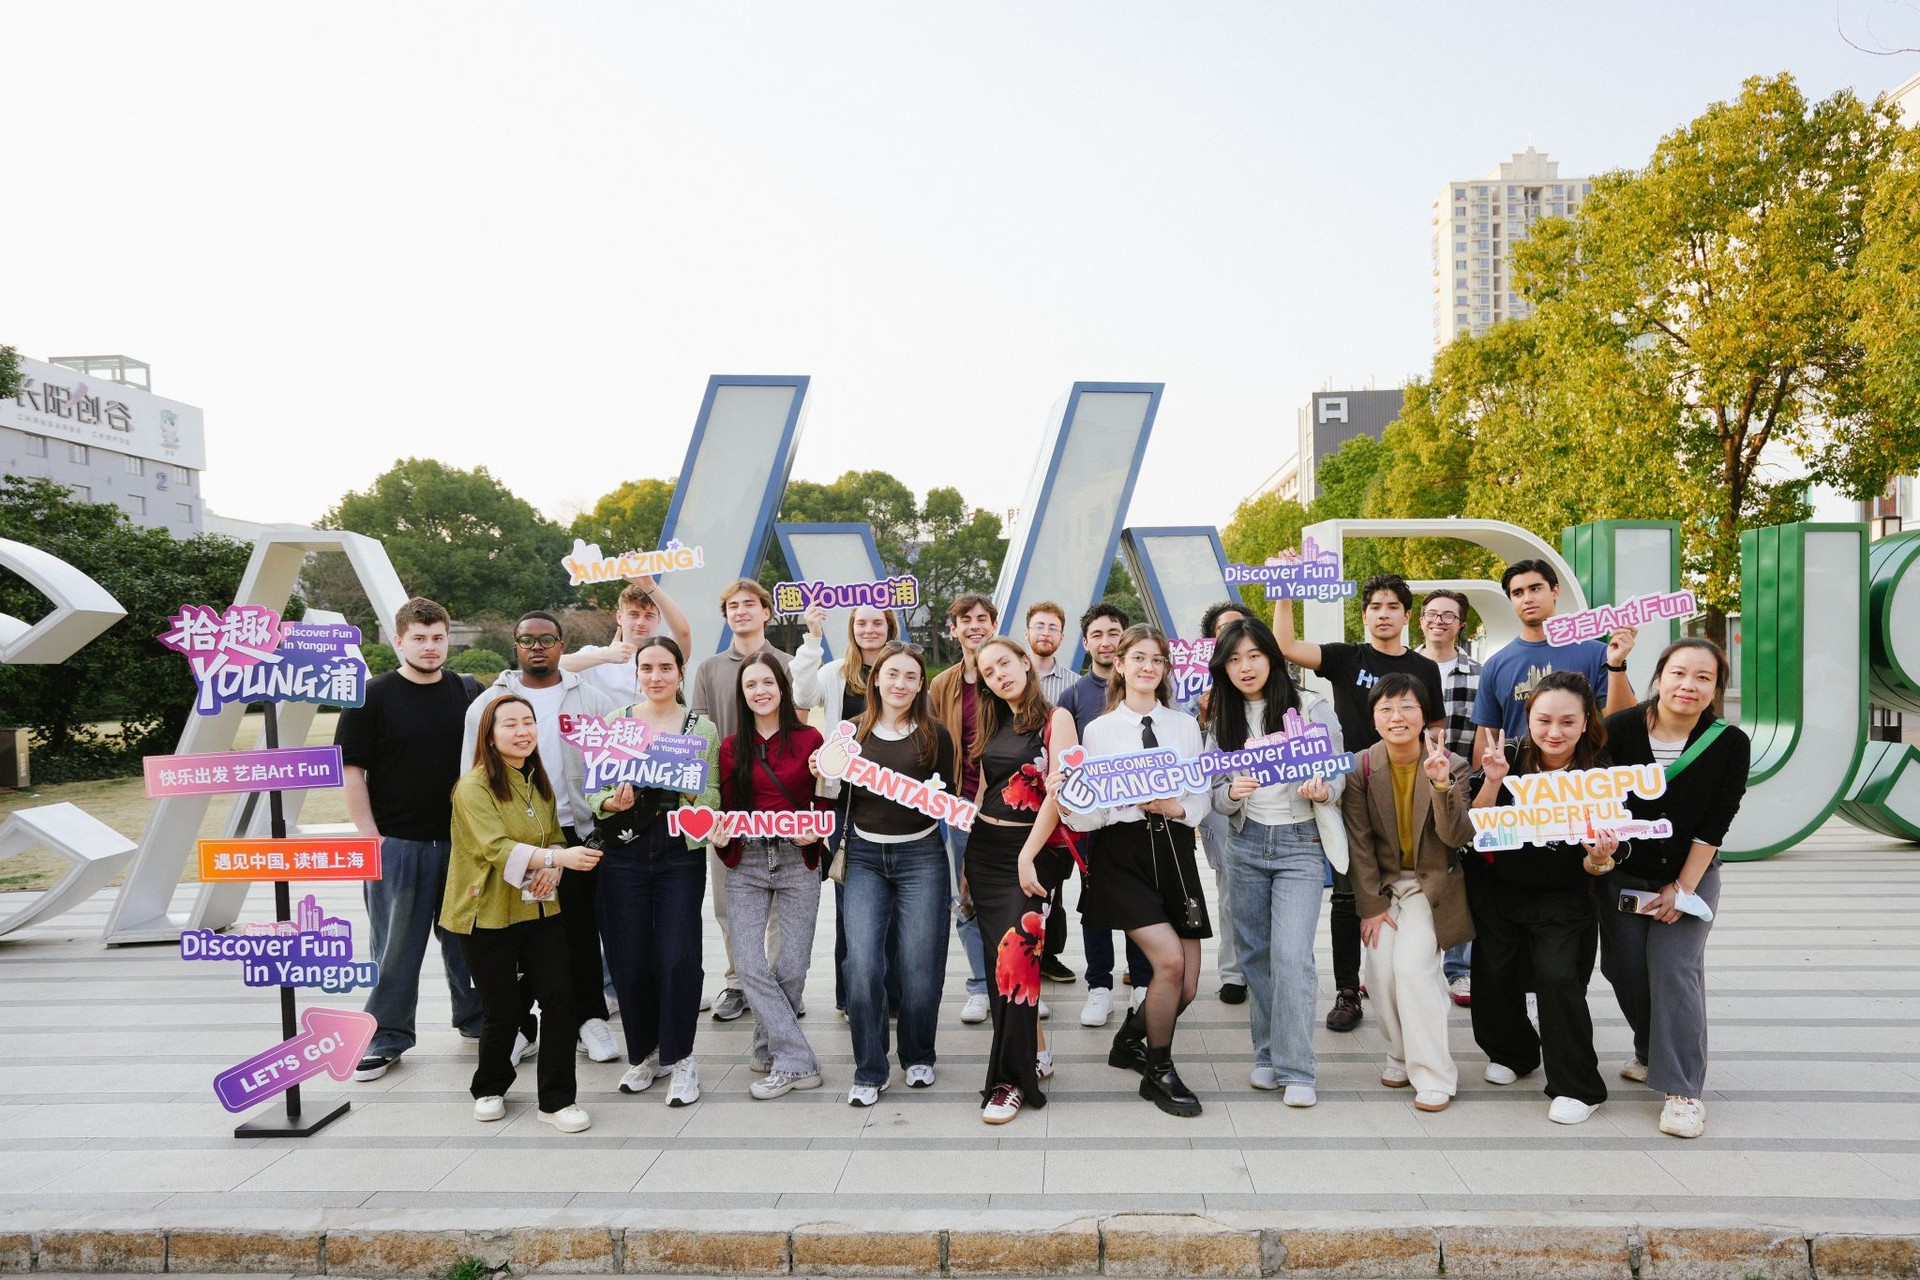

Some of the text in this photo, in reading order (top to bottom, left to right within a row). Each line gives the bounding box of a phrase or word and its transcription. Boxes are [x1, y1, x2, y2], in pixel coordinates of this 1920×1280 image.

[156, 471, 169, 491] 2
[573, 547, 703, 582] AMAZING!
[1225, 564, 1335, 582] Discover Fun
[778, 579, 916, 611] 趣Young浦
[1266, 582, 1353, 602] in Yangpu
[1551, 594, 1693, 641] 艺启Art Fun
[165, 610, 284, 664] 拾趣
[284, 627, 353, 639] Discover Fun
[284, 640, 337, 653] in Yangpu
[192, 652, 358, 710] YOUNG浦
[566, 718, 651, 760] 拾趣
[652, 743, 690, 755] in Yangpu
[653, 734, 702, 746] Discover Fun
[584, 751, 703, 790] YOUNG浦
[1085, 753, 1175, 777] WELCOME TO
[1202, 738, 1327, 774] Discover Fun
[1252, 756, 1351, 785] in Yangpu
[159, 762, 330, 786] 快乐出发 艺启Art Fun
[1089, 762, 1206, 801] YANGPU
[1509, 766, 1663, 807] YANGPU
[846, 757, 976, 829] FANTASY!
[669, 813, 677, 835] I
[1474, 801, 1628, 830] WONDERFUL
[182, 934, 346, 957] Discover Fun
[246, 961, 372, 989] in Yangpu
[240, 1031, 345, 1093] LET’S GO!
